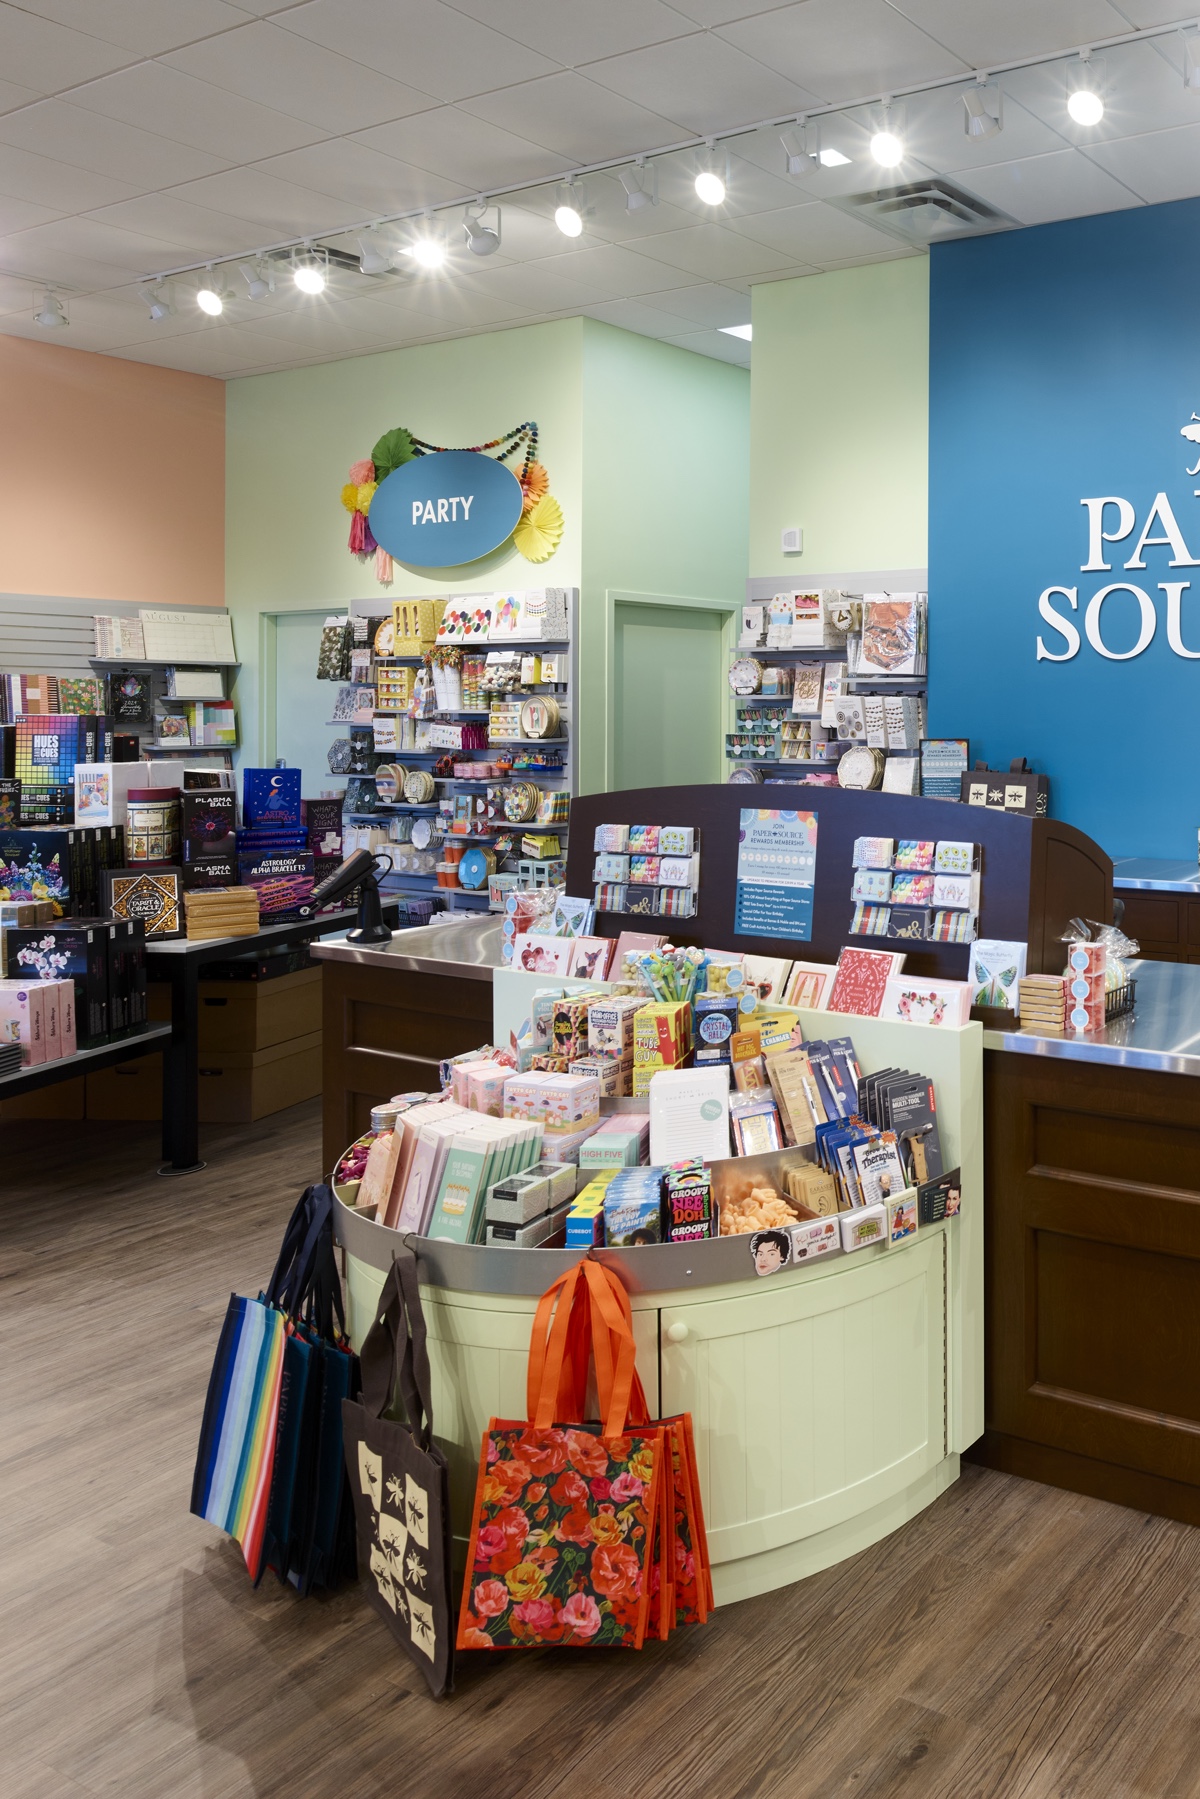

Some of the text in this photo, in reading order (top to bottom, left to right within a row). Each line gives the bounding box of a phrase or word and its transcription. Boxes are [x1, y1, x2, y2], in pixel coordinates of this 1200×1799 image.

[412, 495, 474, 526] PARTY
[144, 612, 188, 622] AUGUST
[33, 734, 59, 748] HUES
[40, 748, 58, 758] CUES
[311, 804, 338, 813] WHAT'S
[313, 818, 338, 827] SIGN?
[777, 831, 804, 839] SOURCE
[260, 858, 297, 868] ASTROLOGY
[250, 864, 306, 875] ALPHA BRACELETS
[702, 1021, 729, 1033] CRYSTAL
[708, 1031, 723, 1040] BALL
[765, 1033, 791, 1045] CHANGER
[636, 1037, 658, 1050] TUBE
[635, 1050, 658, 1062] GUY
[892, 1098, 921, 1109] MULTI-TOOL
[581, 1150, 602, 1159] HIGH
[862, 1151, 897, 1170] Therapist
[670, 1186, 709, 1199] GROOVY
[809, 1183, 834, 1194] EARASER
[672, 1195, 703, 1212] NEE
[610, 1211, 640, 1225] THE JOY
[674, 1209, 704, 1224] DOH
[610, 1214, 657, 1232] OF PAINTING
[671, 1223, 709, 1236] GROOVY
